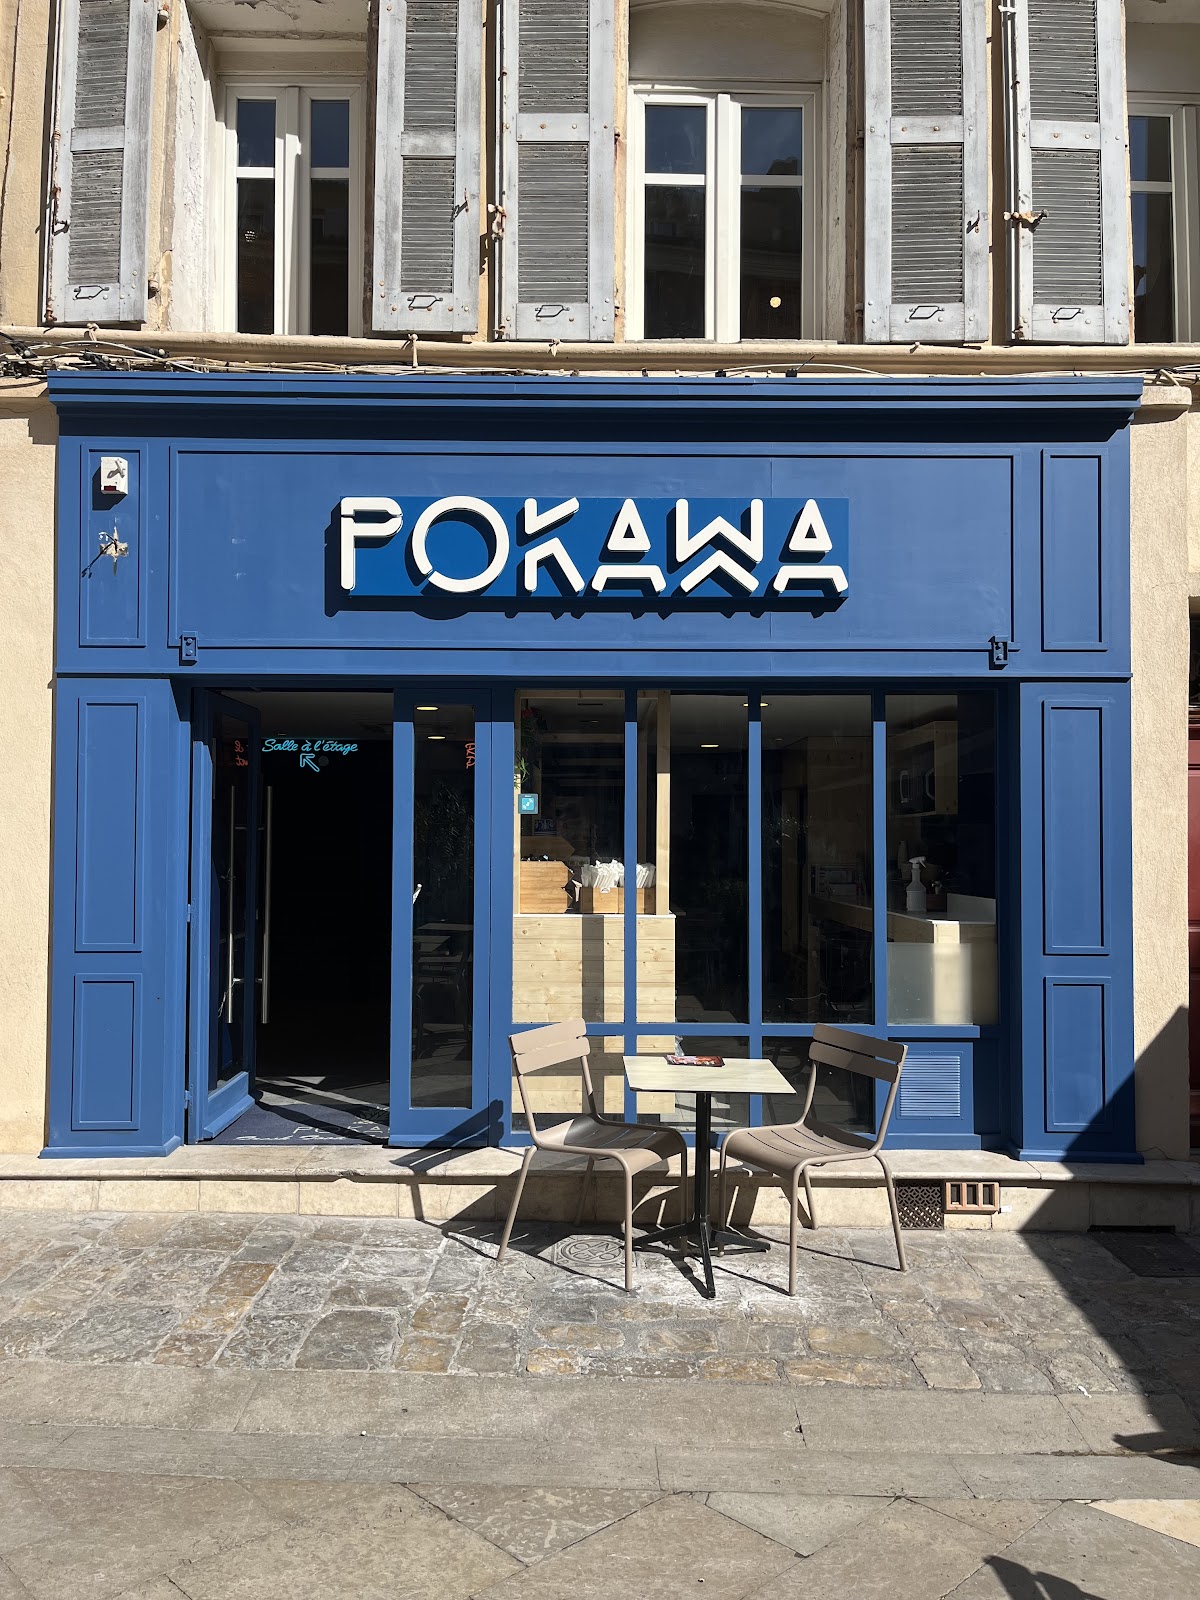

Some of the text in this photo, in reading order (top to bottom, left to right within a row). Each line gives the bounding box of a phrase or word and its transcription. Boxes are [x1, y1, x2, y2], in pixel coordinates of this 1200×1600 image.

[341, 496, 849, 593] POKAWA
[262, 739, 358, 755] Salle à l'étage
